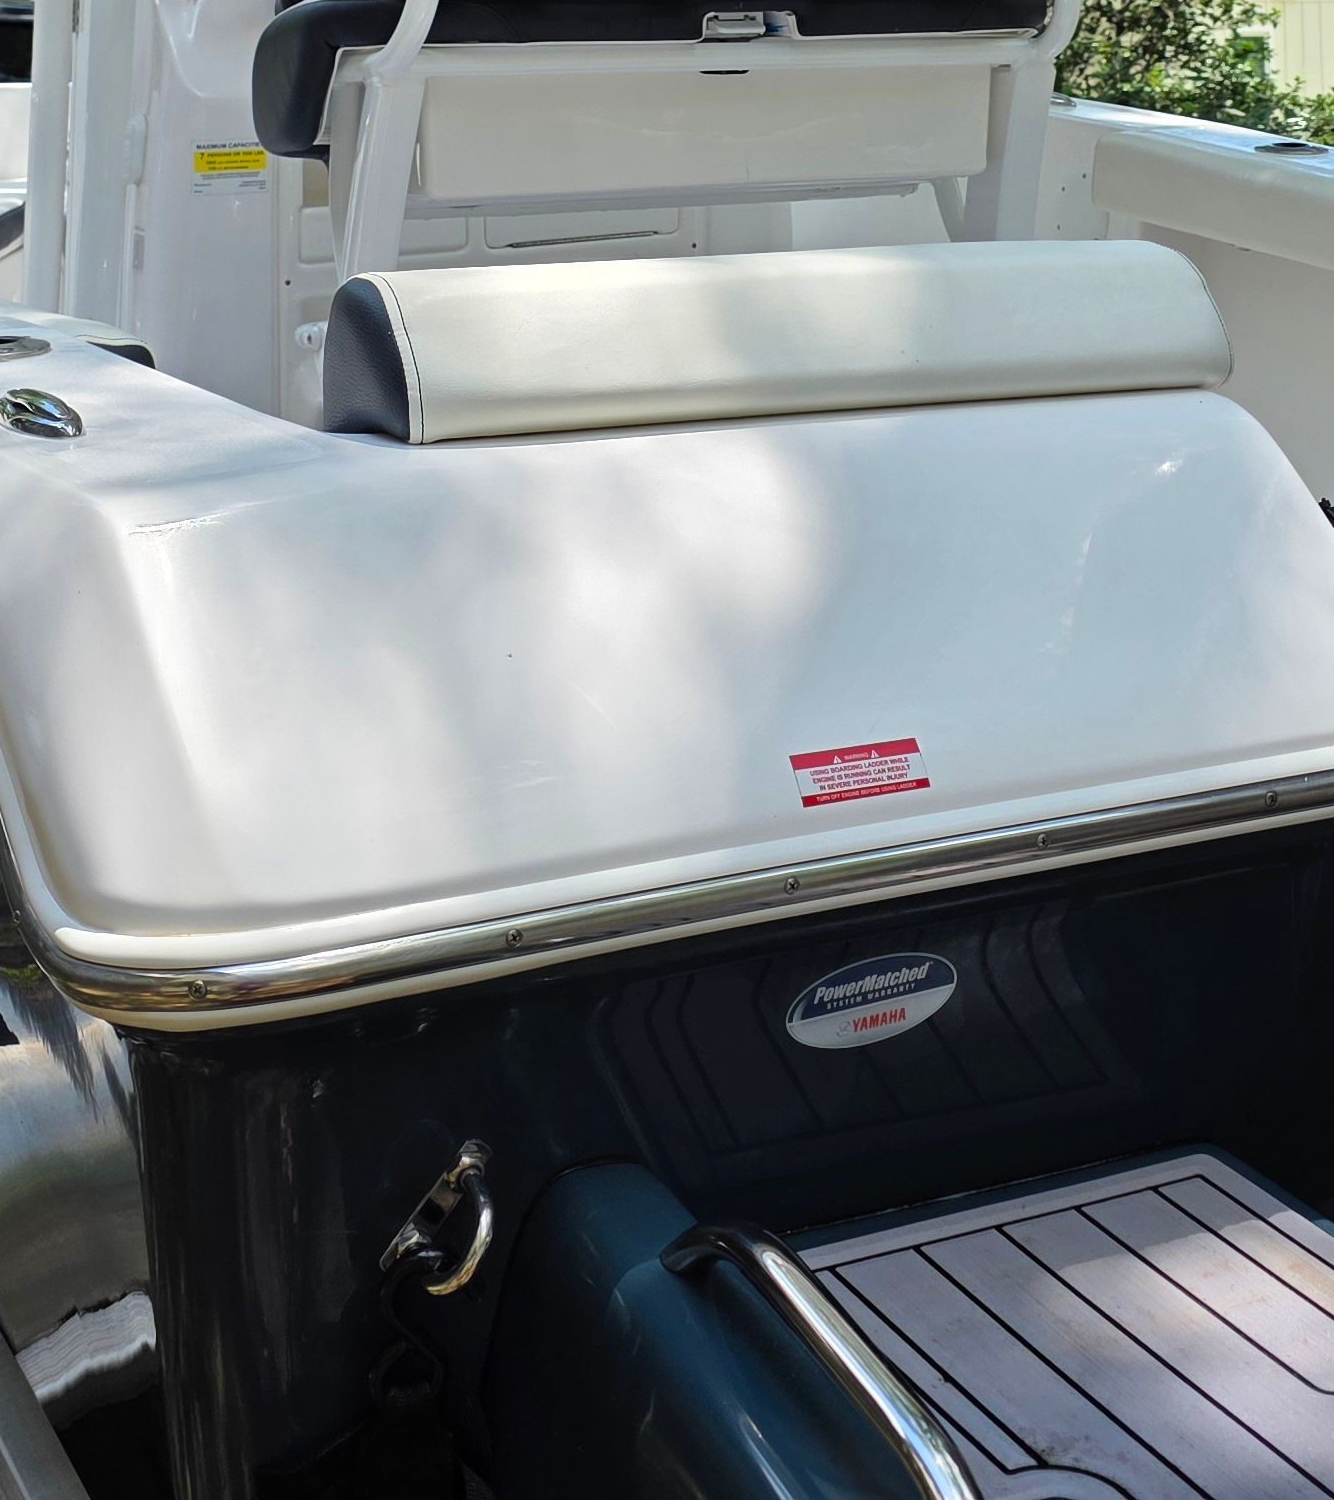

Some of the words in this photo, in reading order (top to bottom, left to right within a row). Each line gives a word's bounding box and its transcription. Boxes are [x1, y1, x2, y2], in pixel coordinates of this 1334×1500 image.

[228, 141, 260, 149] CAPACITIE
[809, 767, 829, 776] USING
[830, 763, 863, 773] BOARDING
[864, 759, 889, 769] LADDER
[889, 756, 909, 765] WHILE
[812, 775, 836, 784] ENGINE
[844, 768, 872, 780] RUNNING
[873, 767, 886, 776] CAN
[886, 763, 910, 773] RESULT
[827, 781, 852, 790] SEVERE
[853, 775, 885, 787] PERSONAL
[886, 771, 908, 781] INJURY
[813, 961, 930, 1005] PowerMatched
[827, 995, 862, 1010] SYSTEM
[867, 982, 916, 1000] WARRANTY
[852, 1007, 906, 1033] YAMAHA
